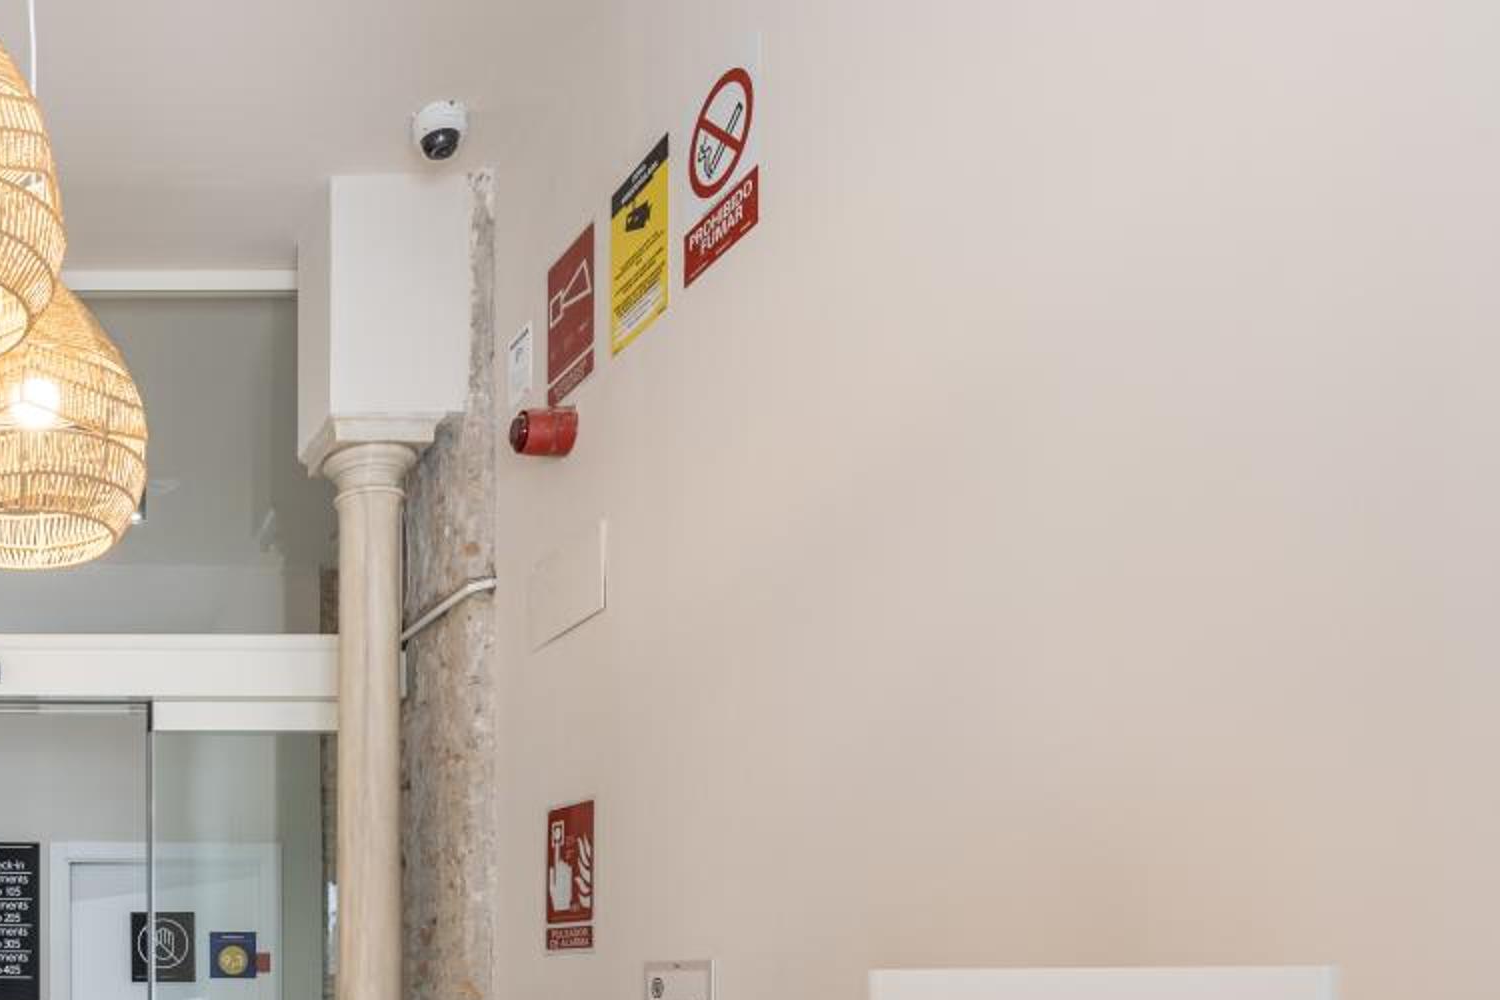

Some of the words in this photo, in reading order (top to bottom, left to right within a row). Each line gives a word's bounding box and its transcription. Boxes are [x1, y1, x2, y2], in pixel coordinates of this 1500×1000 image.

[689, 179, 752, 252] PROHIBIDO
[701, 205, 743, 255] FUMAR
[4, 886, 21, 896] 105
[3, 912, 21, 922] 205
[3, 938, 21, 949] 305
[3, 964, 21, 975] 405
